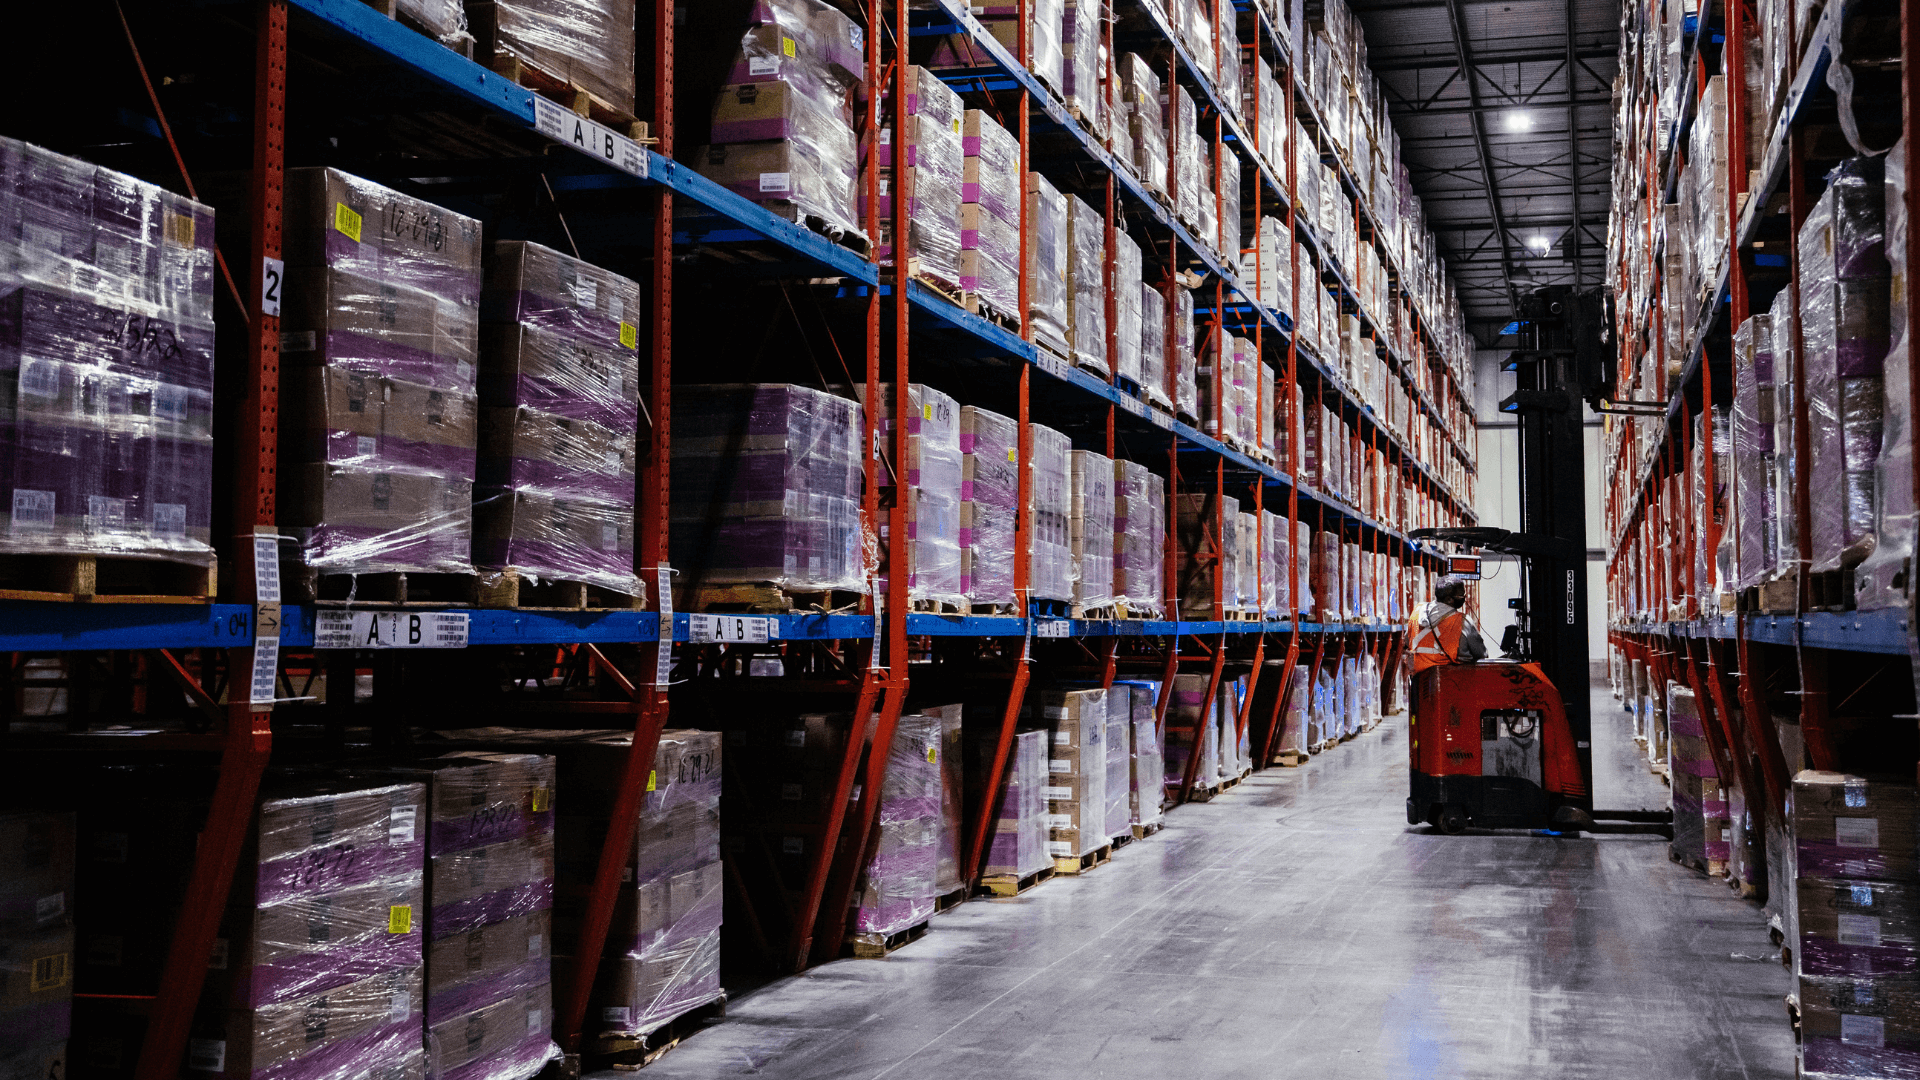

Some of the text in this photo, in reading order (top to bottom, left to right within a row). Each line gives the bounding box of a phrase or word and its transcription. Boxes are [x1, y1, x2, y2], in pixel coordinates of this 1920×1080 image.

[574, 120, 615, 159] A B
[266, 270, 279, 302] 2
[875, 437, 878, 453] 2
[229, 614, 247, 637] 04
[367, 614, 379, 645] A
[409, 614, 421, 644] B
[715, 618, 723, 639] A
[736, 619, 744, 640] B
